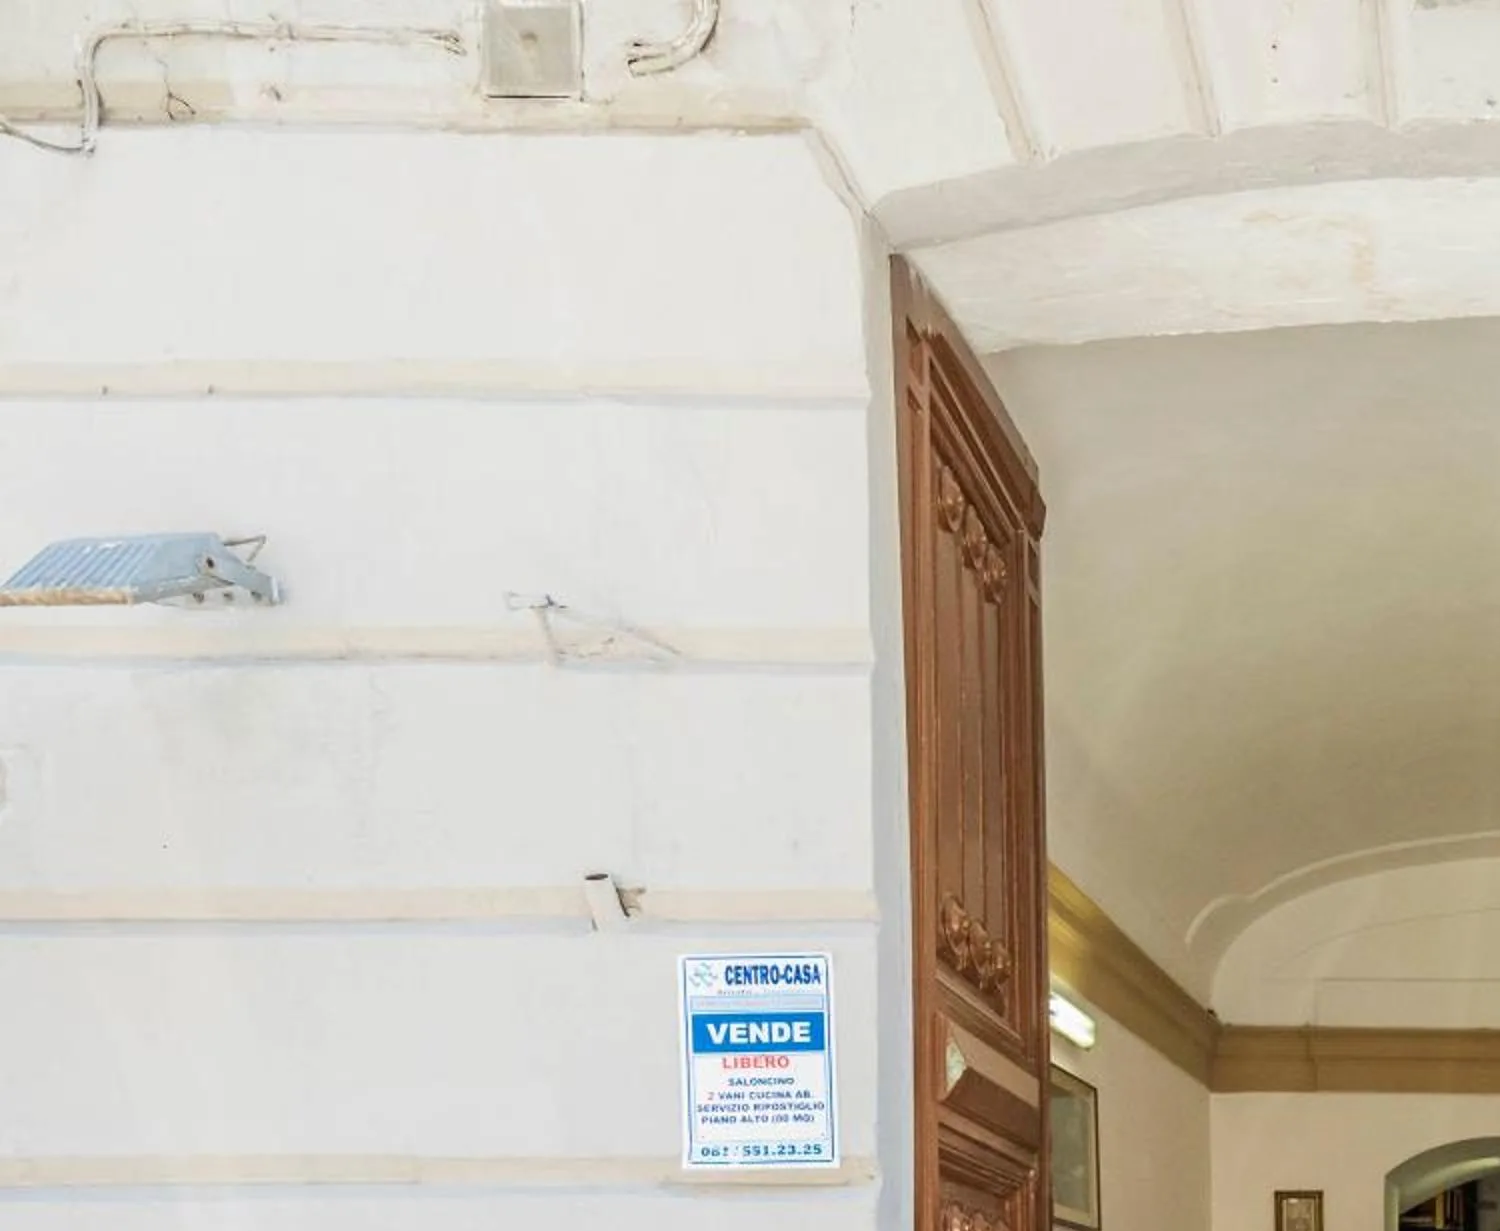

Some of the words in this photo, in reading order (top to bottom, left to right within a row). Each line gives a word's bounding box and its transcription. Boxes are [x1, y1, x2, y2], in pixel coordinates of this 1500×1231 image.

[724, 964, 822, 985] CENTRO-CASA
[706, 1021, 812, 1044] VENDE
[722, 1055, 790, 1069] LIBERO
